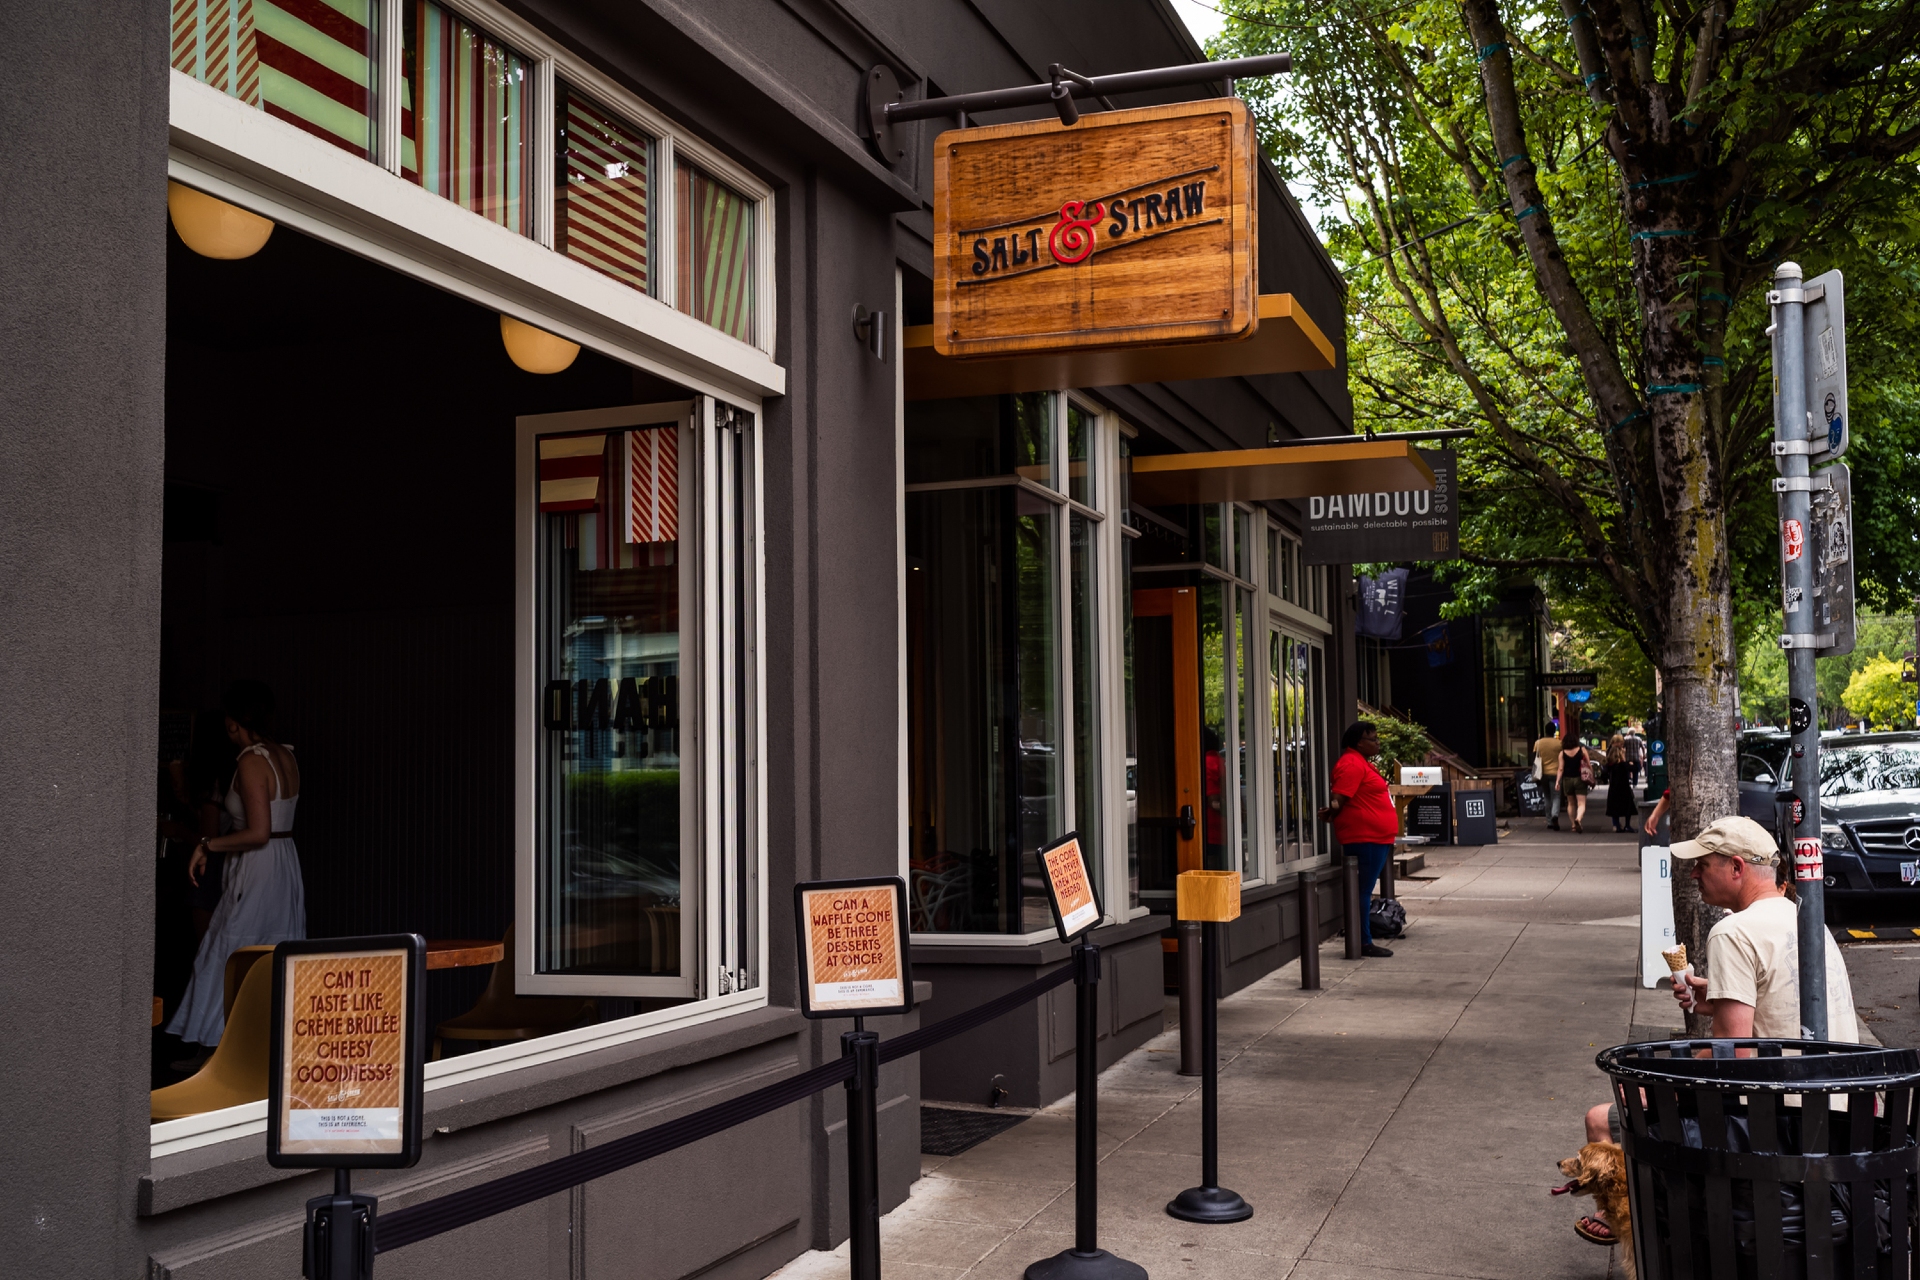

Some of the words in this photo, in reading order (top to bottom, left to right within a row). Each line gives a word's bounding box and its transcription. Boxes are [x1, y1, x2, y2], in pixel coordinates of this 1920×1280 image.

[971, 227, 1044, 276] SALT
[1049, 200, 1106, 264] &
[1108, 180, 1206, 237] STRAW
[1433, 468, 1448, 514] SUSHI
[1310, 521, 1359, 532] sustainable
[1363, 519, 1408, 529] delectable
[1412, 517, 1448, 529] possible
[1048, 855, 1060, 868] THE
[832, 899, 858, 911] CAN
[861, 898, 869, 909] A
[812, 912, 853, 926] WAFFLE
[855, 910, 891, 923] CONE
[827, 927, 841, 939] BE
[844, 924, 878, 938] THREE
[827, 939, 881, 953] DESSERTS
[826, 955, 838, 967] AT
[842, 952, 883, 966] ONCE?
[323, 971, 354, 989] CAN
[359, 969, 372, 988] IT
[310, 995, 348, 1013] TASTE
[353, 992, 383, 1011] LIKE
[295, 1014, 343, 1036] CRÈME
[346, 1011, 398, 1035] BRÛLÉE
[317, 1040, 374, 1059] CHEESY
[297, 1064, 393, 1083] GOODNESS?
